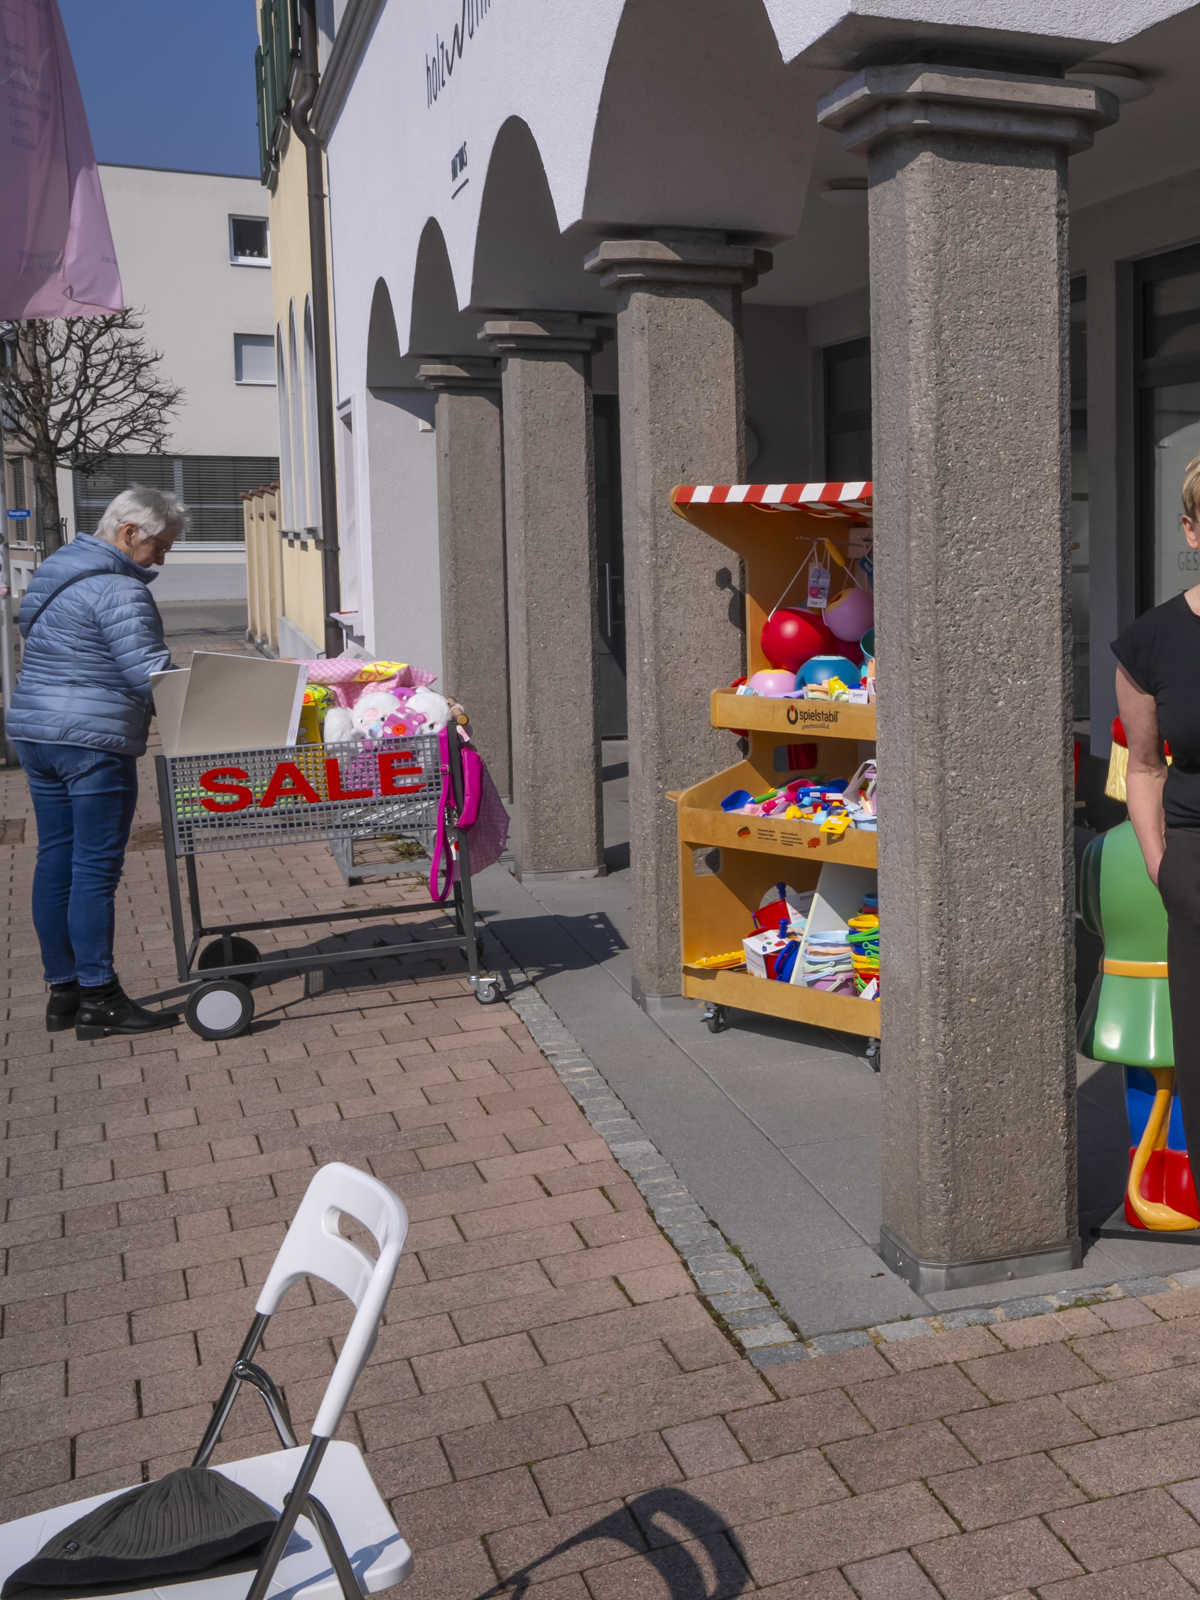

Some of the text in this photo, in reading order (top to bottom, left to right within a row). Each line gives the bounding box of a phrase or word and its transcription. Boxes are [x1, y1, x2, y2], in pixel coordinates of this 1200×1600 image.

[9, 115, 30, 131] Lesen
[799, 708, 839, 724] spielstabil
[199, 750, 428, 814] SALE
